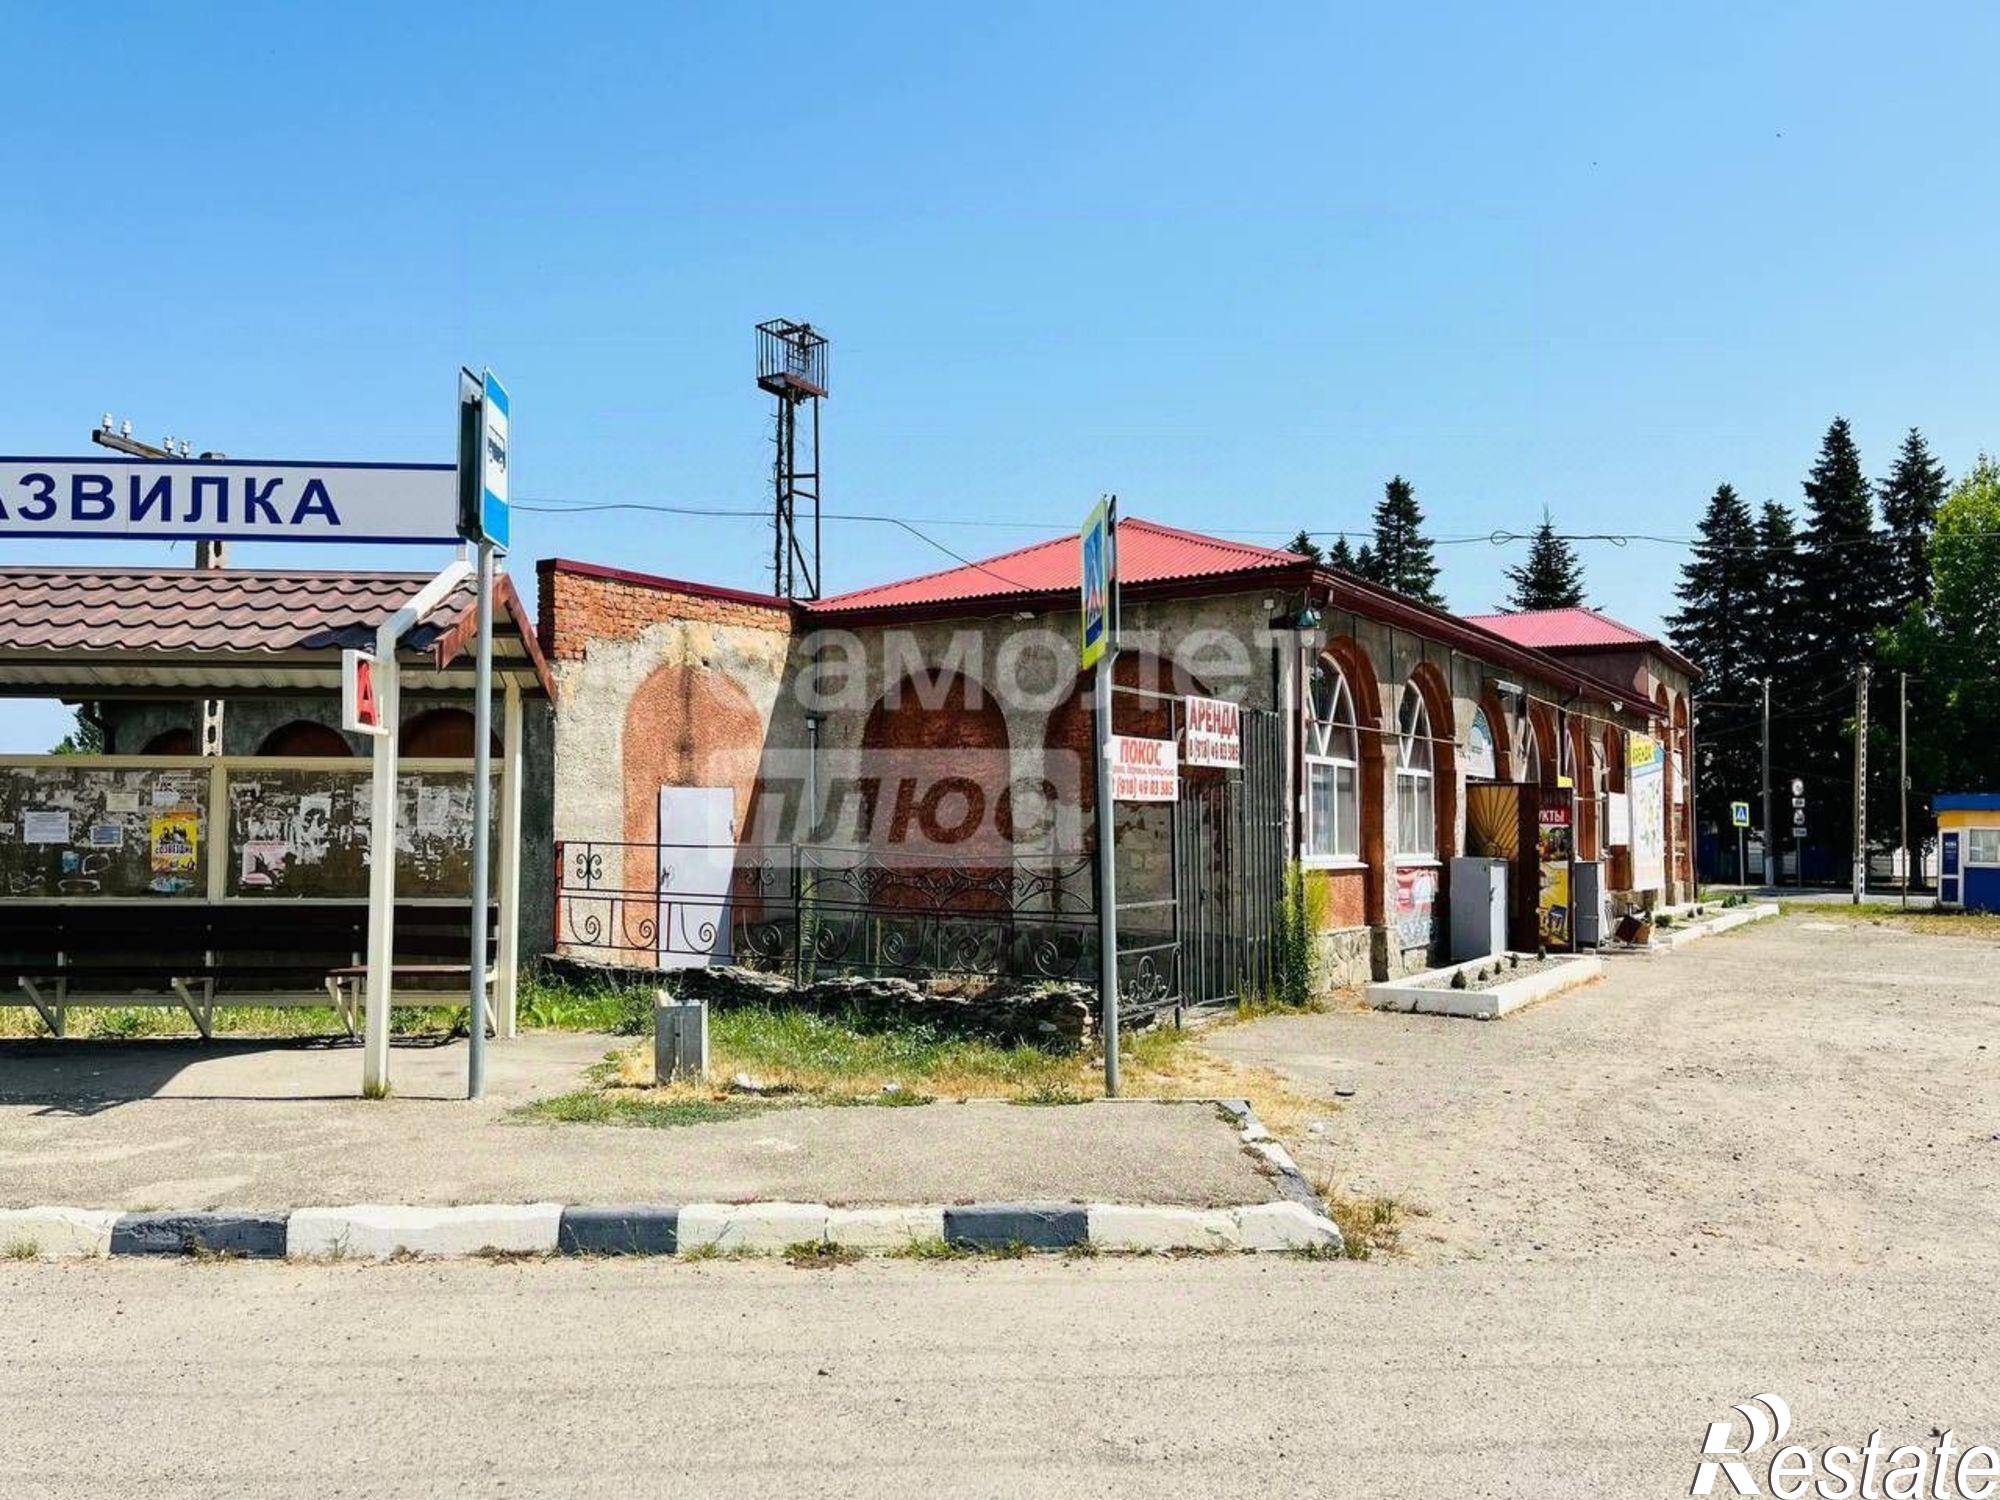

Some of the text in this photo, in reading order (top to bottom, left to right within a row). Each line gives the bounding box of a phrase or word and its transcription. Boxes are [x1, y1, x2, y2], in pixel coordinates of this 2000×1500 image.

[0, 473, 341, 525] ЗВИЛКА
[1189, 699, 1238, 739] АРЕНДА
[1120, 738, 1162, 766] ПОКОС
